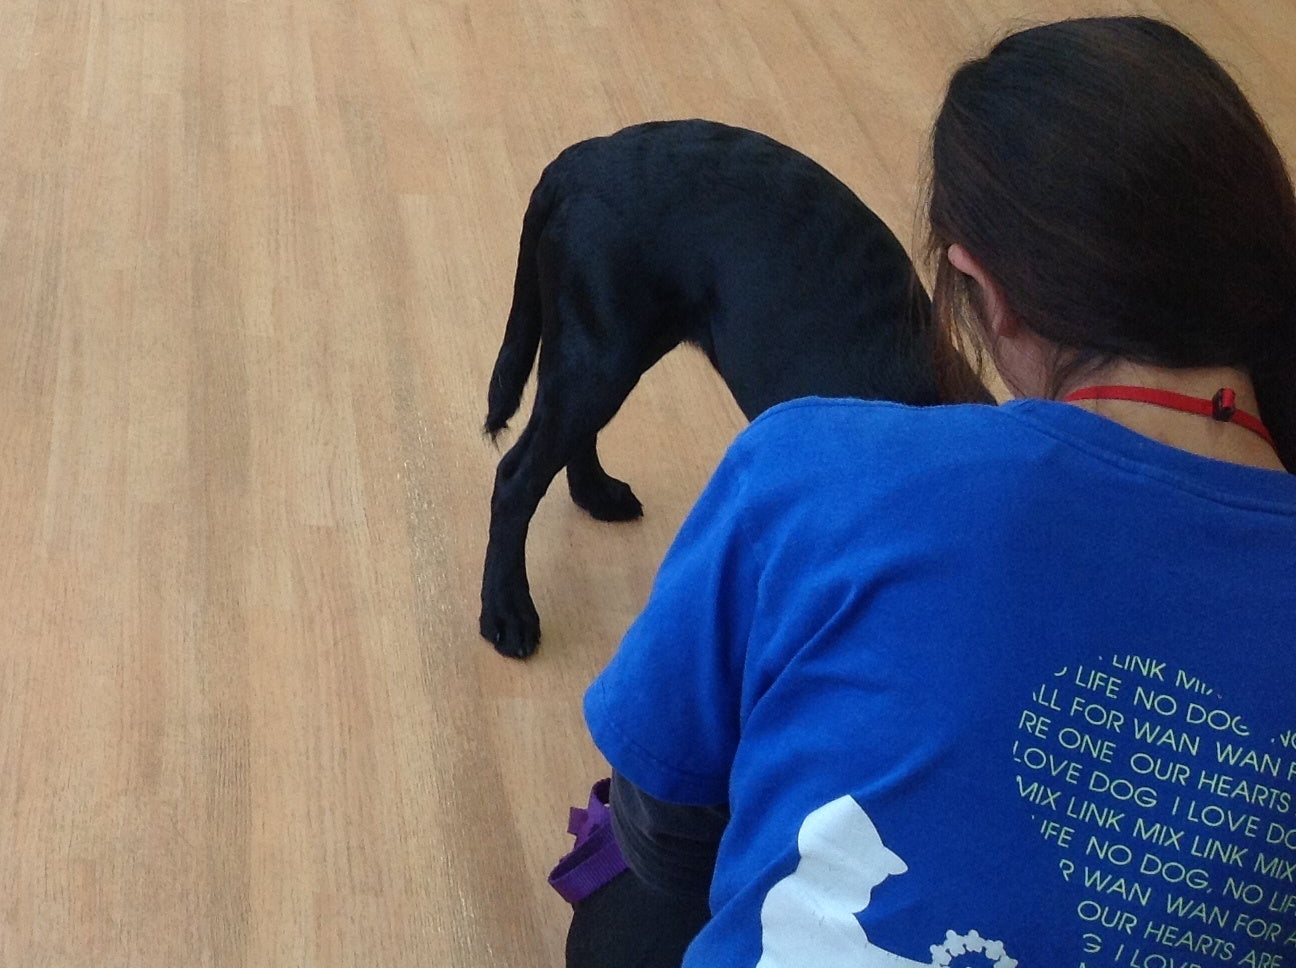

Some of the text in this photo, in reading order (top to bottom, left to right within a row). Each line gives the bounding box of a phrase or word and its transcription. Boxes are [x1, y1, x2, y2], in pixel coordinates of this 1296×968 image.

[1075, 664, 1122, 699] LIFE
[1133, 685, 1178, 716] NO
[1112, 654, 1167, 682] LINK
[1057, 727, 1117, 764] ONE
[1130, 752, 1191, 787] OUR
[1197, 769, 1292, 814] HEARTS
[1069, 696, 1125, 734] FOR
[1133, 717, 1201, 757] WAN
[1216, 741, 1282, 778] WAN
[1012, 740, 1083, 785] LOVE
[1088, 770, 1158, 808] DOG
[1171, 796, 1181, 816] I
[1187, 800, 1261, 838] LOVE
[1015, 774, 1296, 883] MIX LINK MIX LINK MIX
[1084, 866, 1152, 907] WAN
[1166, 893, 1230, 929] WAN
[1233, 913, 1282, 943] FOR
[1085, 835, 1133, 866] NO
[1222, 877, 1264, 905] NO
[1268, 891, 1296, 913] LIF
[1077, 900, 1138, 935] OUR
[1143, 920, 1236, 961] HEARTS
[1114, 943, 1125, 962] I
